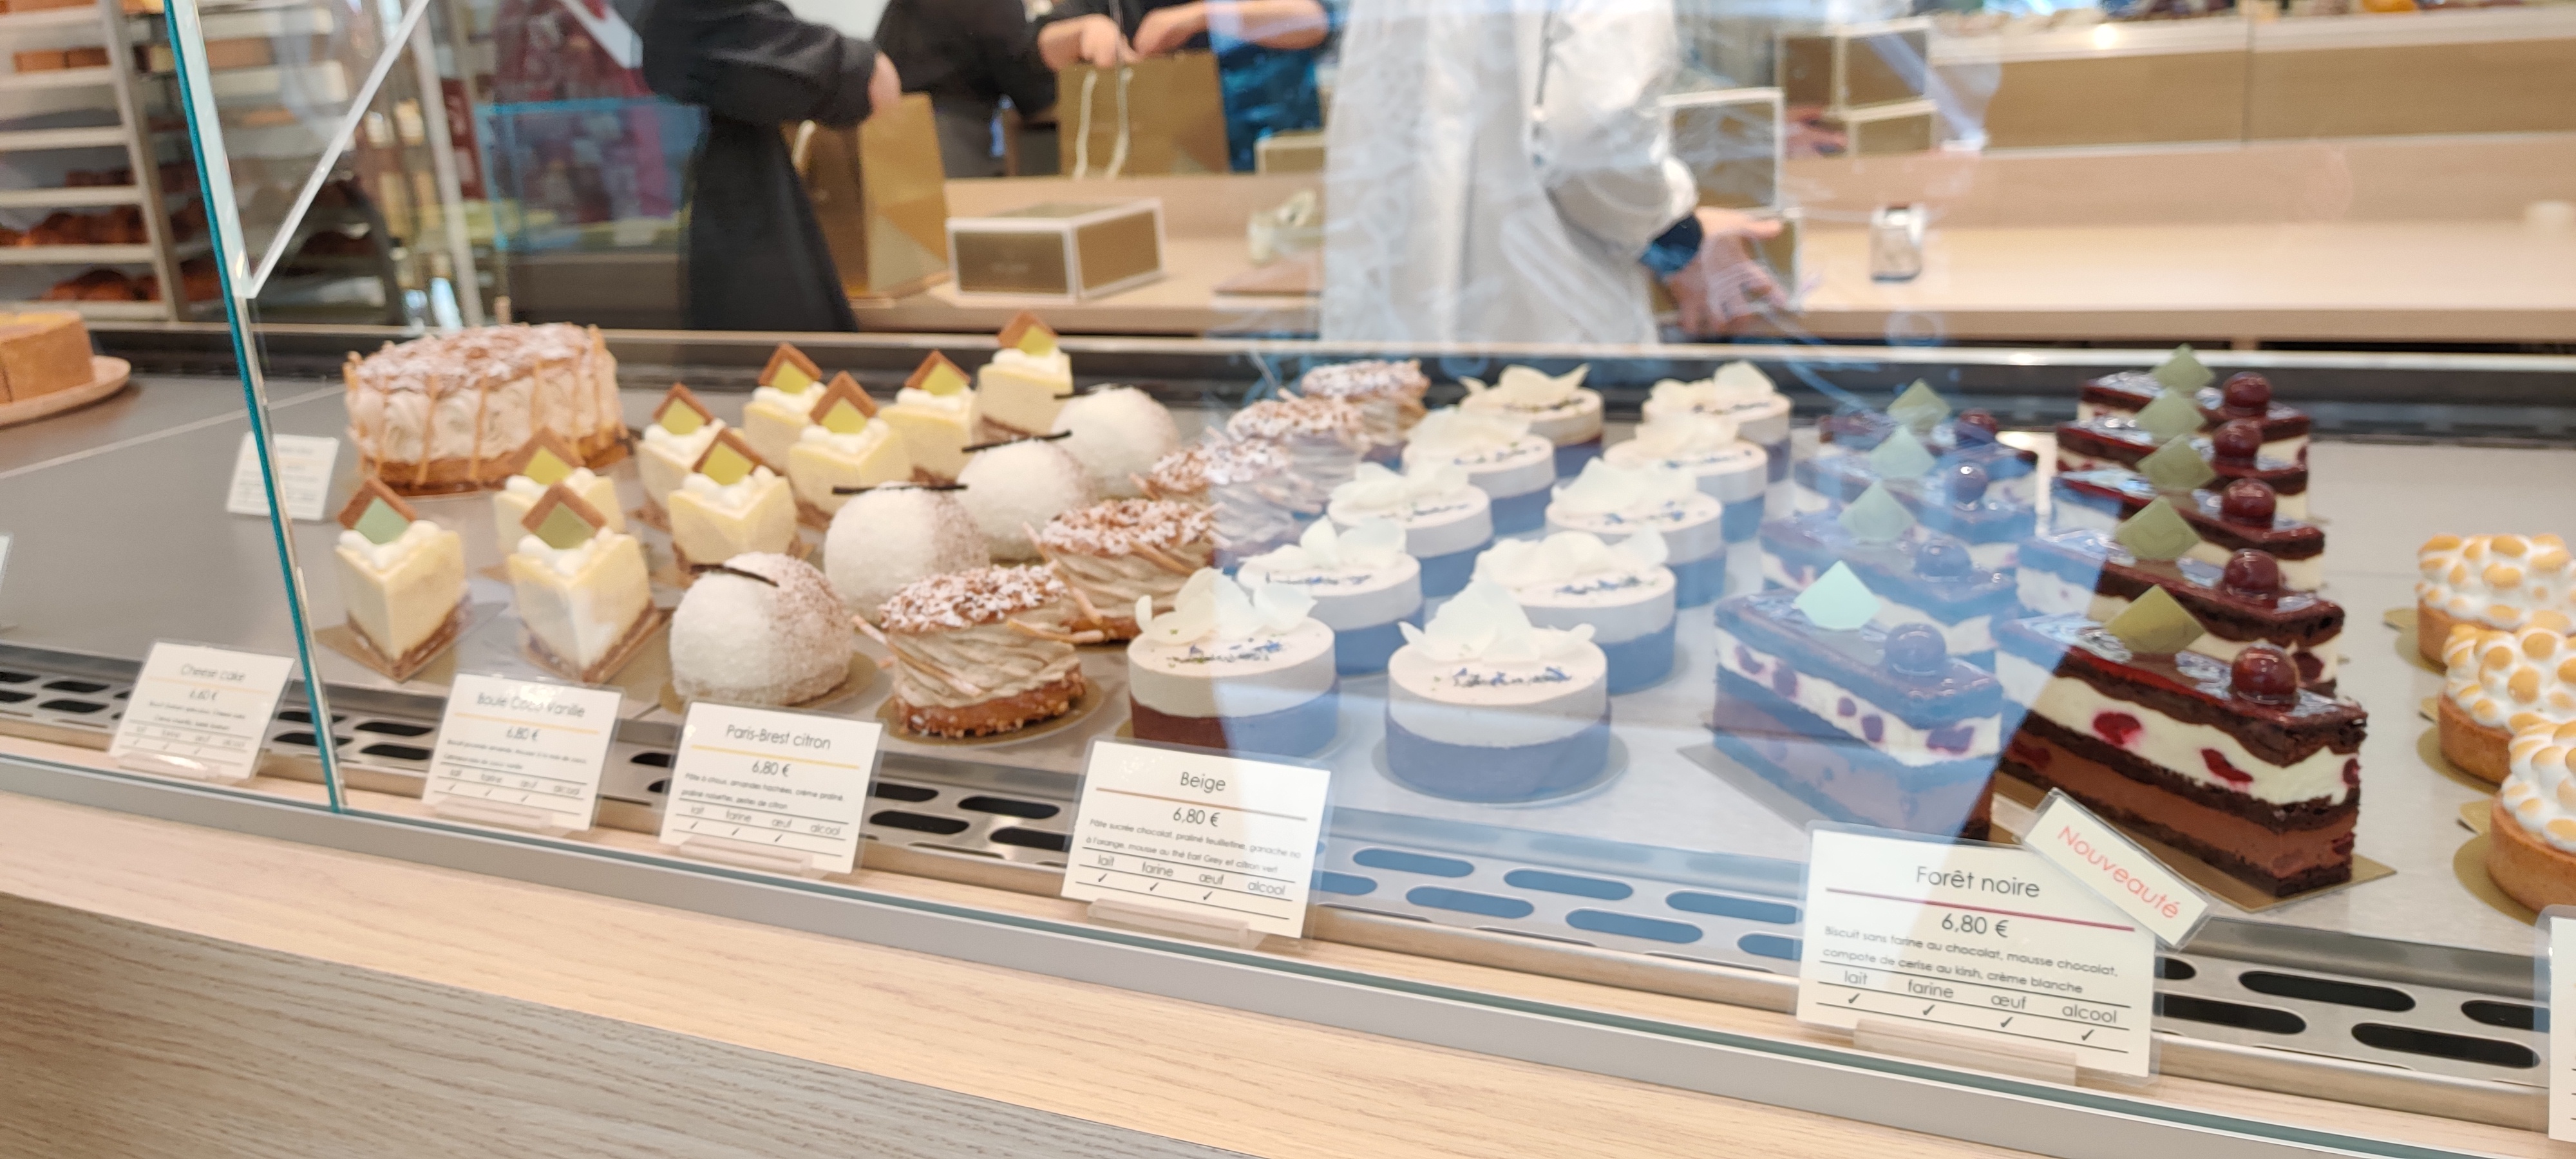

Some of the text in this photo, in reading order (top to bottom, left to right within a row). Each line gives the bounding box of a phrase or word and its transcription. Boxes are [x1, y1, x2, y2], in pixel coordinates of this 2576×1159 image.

[726, 723, 831, 750] Paris-Brest citron
[752, 759, 791, 778] 6,80 €
[1180, 771, 1226, 793] Beige
[726, 809, 752, 823] farine
[810, 824, 841, 836] alcool
[1173, 806, 1220, 828] 6,80 €
[1128, 843, 1157, 854] mousse
[1172, 849, 1186, 858] thé
[1187, 851, 1202, 861] Earl
[1204, 854, 1223, 866] Grey
[1236, 860, 1260, 870] citron
[1249, 845, 1287, 857] ganache
[1097, 854, 1285, 895] lait farine œuf alcool
[1916, 865, 2041, 898] Forêt noire
[2056, 824, 2181, 920] Nouveauté
[1942, 913, 2009, 938] 6,80 €
[1824, 926, 2118, 977] Biscuit sans farine au chocolat, mousse chocolat,
[1823, 948, 1876, 963] compote
[1880, 955, 1895, 966] de
[1898, 959, 1933, 972] cerise
[1936, 965, 1952, 974] au
[1987, 971, 2027, 986] crème
[2031, 976, 2083, 994] blanche
[1844, 970, 2117, 1024] lait farine œuf alcool
